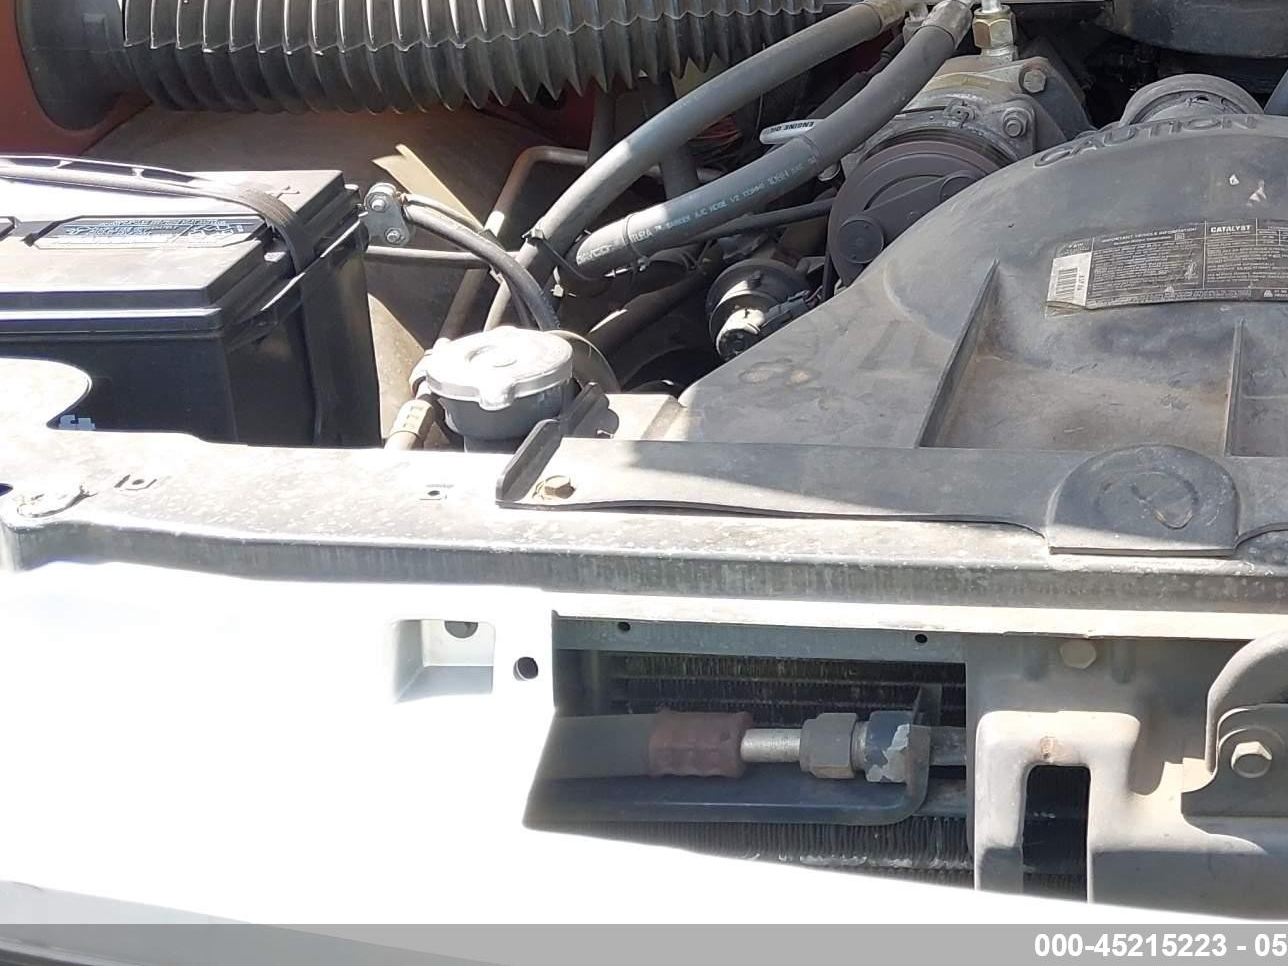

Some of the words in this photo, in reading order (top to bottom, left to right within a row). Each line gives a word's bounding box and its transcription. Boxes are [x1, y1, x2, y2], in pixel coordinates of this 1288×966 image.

[784, 121, 815, 131] ENGINE
[1033, 115, 1258, 168] CAUTION
[1210, 224, 1252, 234] CATALYST
